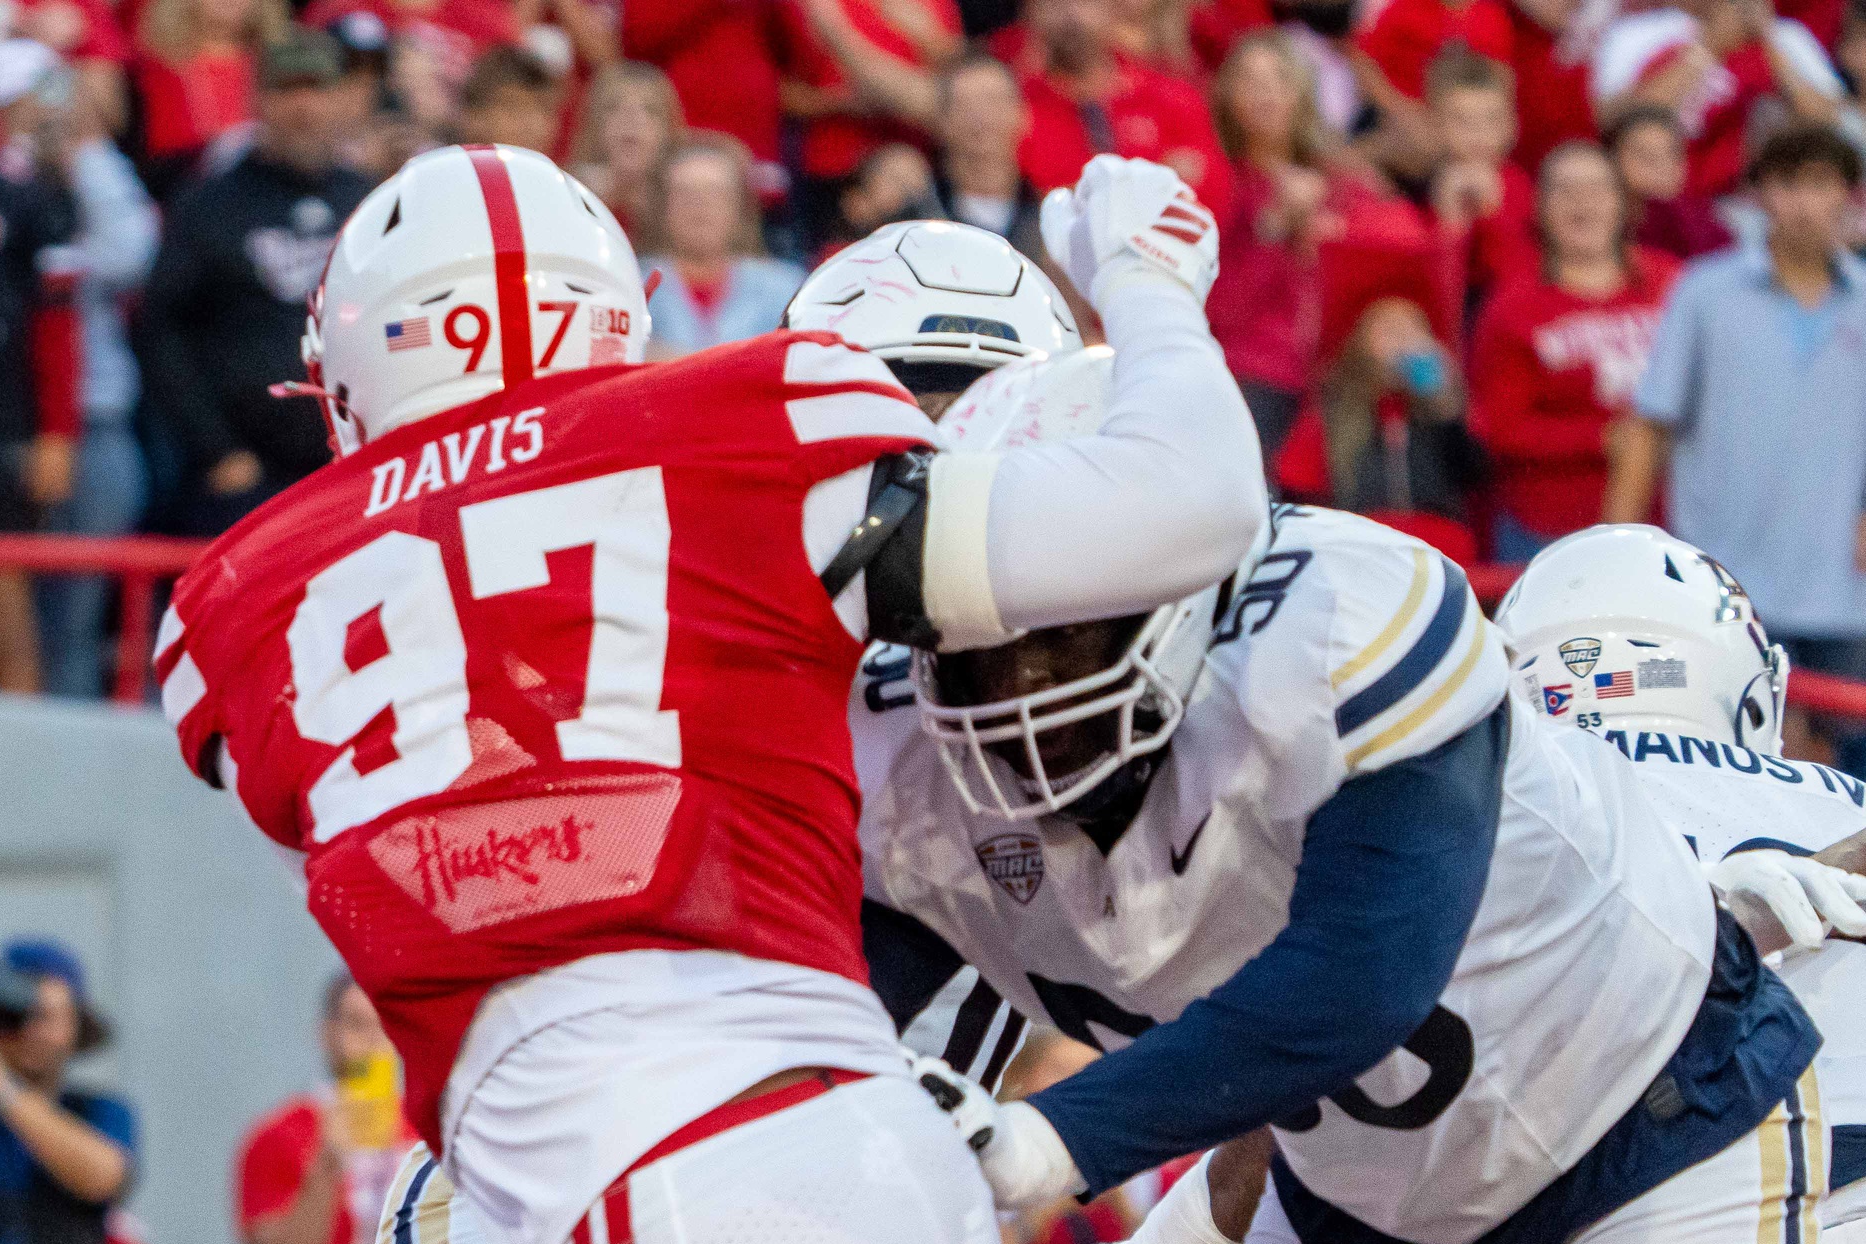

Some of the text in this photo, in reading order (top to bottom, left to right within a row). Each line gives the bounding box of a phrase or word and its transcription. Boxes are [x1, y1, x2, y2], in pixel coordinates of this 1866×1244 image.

[443, 302, 579, 373] 97
[365, 406, 545, 518] DAVIS
[287, 466, 683, 844] 97
[1563, 650, 1601, 664] MAC
[1577, 712, 1602, 729] 53
[413, 814, 583, 908] Huskers
